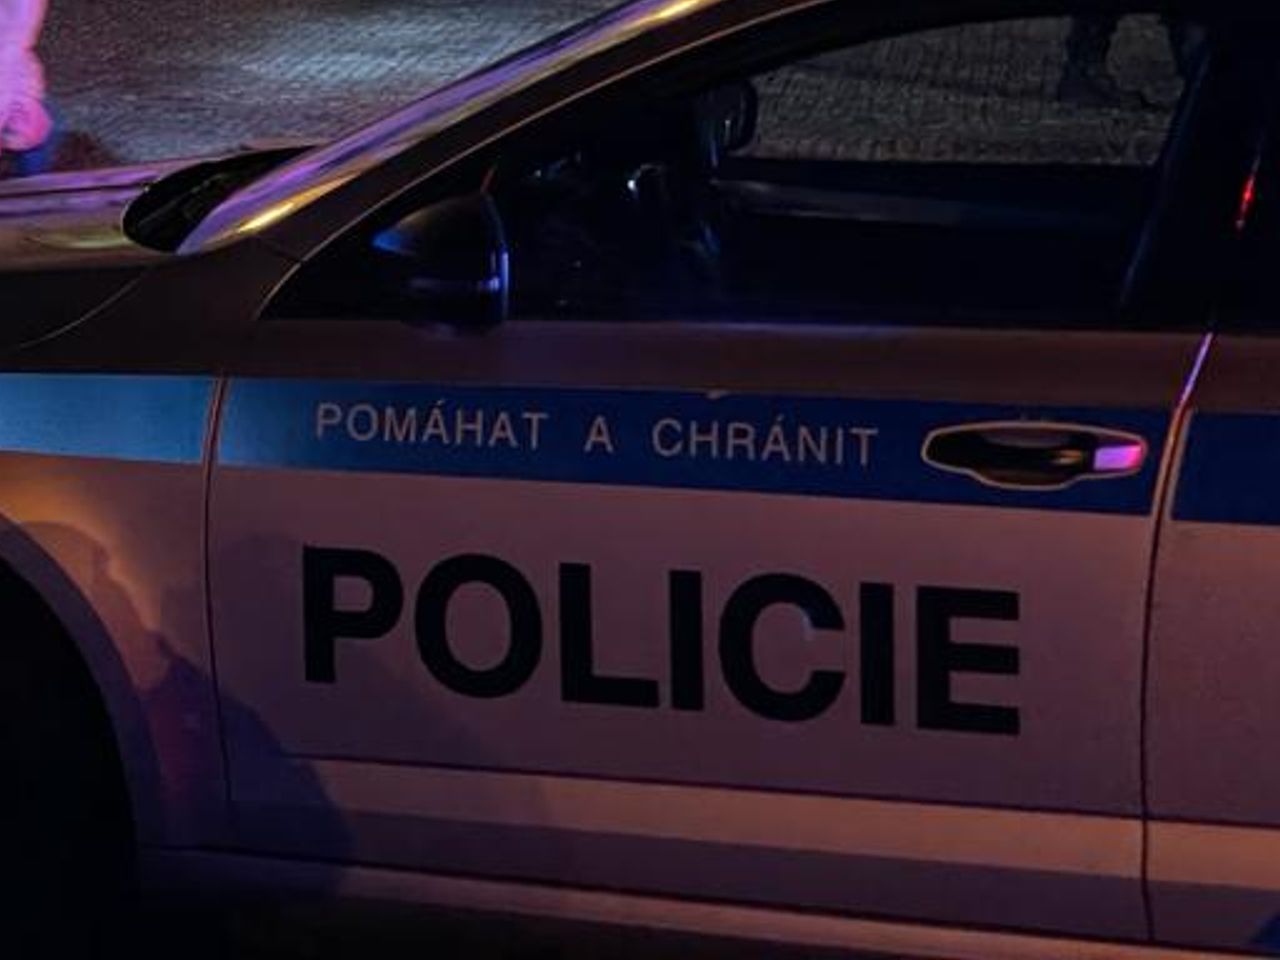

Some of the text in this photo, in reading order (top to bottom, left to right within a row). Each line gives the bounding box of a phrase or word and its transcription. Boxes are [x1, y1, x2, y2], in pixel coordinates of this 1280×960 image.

[316, 399, 880, 467] POMÁHAT A CHRÁNIT
[303, 545, 1022, 737] POLICIE
